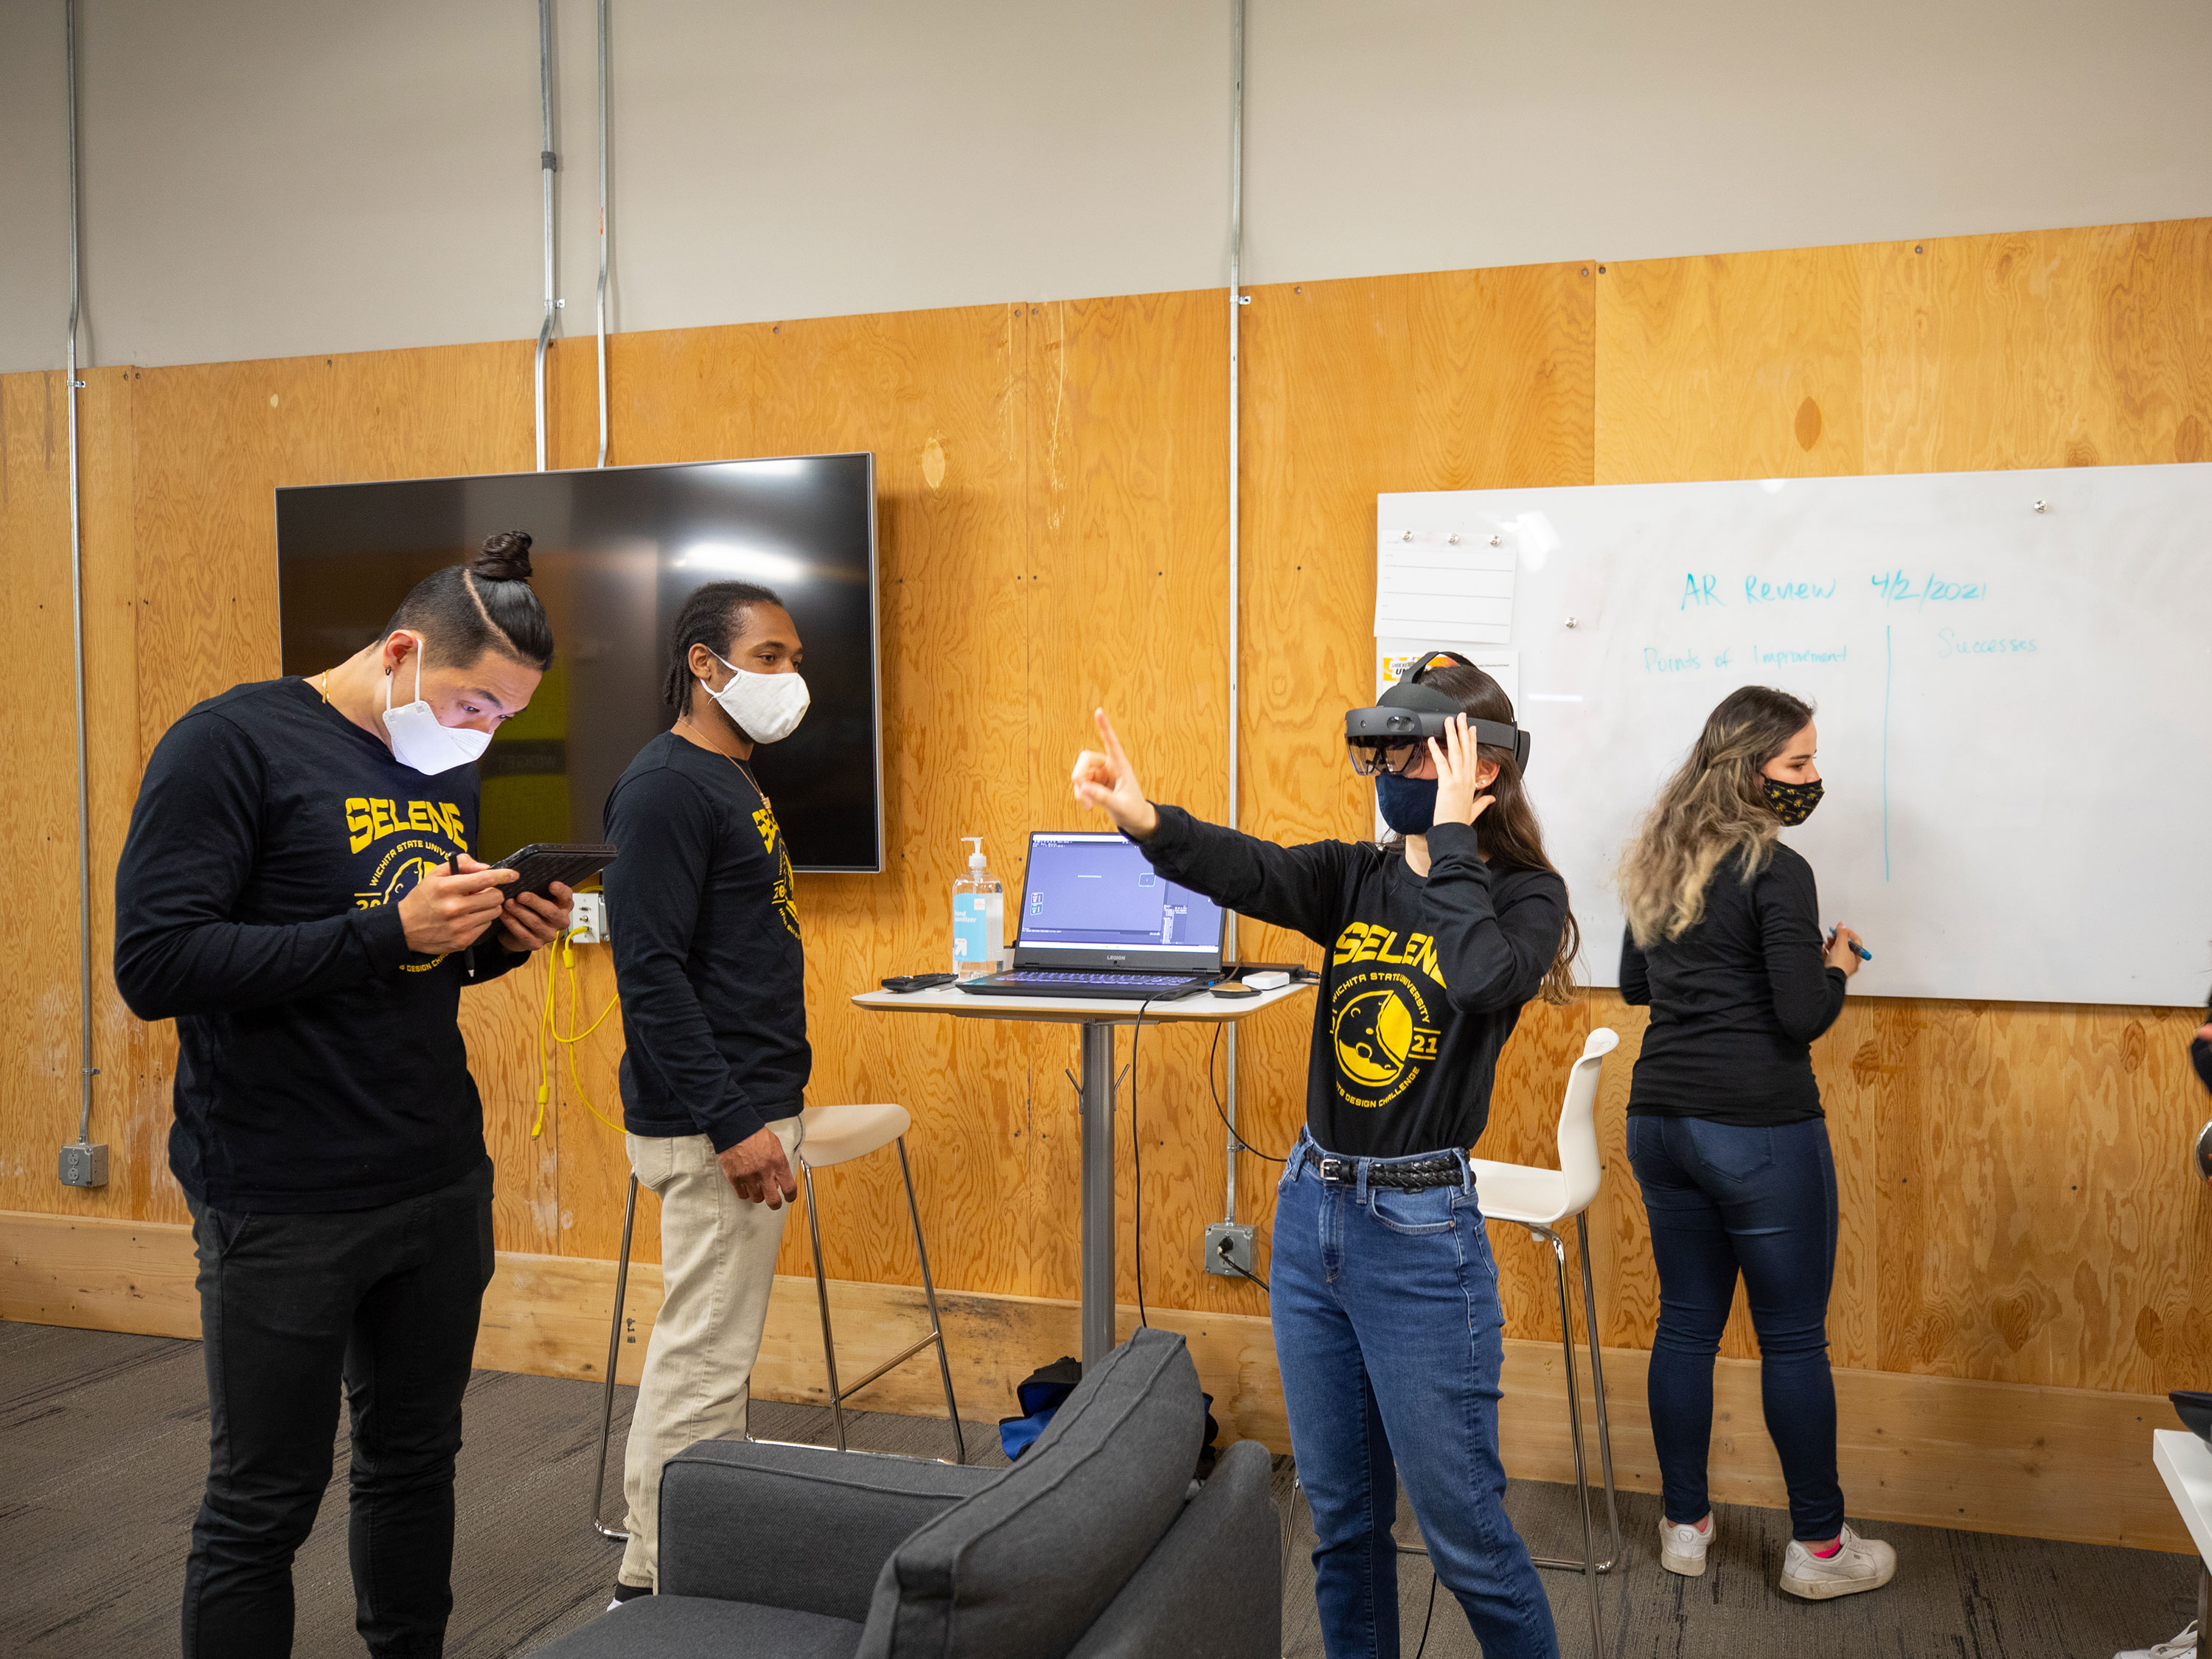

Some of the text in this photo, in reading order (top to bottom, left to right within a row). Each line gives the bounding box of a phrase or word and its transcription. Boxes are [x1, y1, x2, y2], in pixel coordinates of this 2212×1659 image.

[1681, 569, 1986, 613] AR Review 4/2/2021
[1644, 644, 1847, 672] Points of Improvement
[1938, 627, 2037, 658] Successes
[345, 797, 468, 855] SELENE
[369, 840, 450, 886] WICHITA STATE UNIVE
[406, 963, 432, 973] DESIGN
[1332, 973, 1430, 1023] WICHITA STATE UNIVERSITY
[1411, 1034, 1437, 1054] 21
[1345, 1093, 1377, 1107] DESIGN
[1379, 1066, 1420, 1107] CHALLENGE
